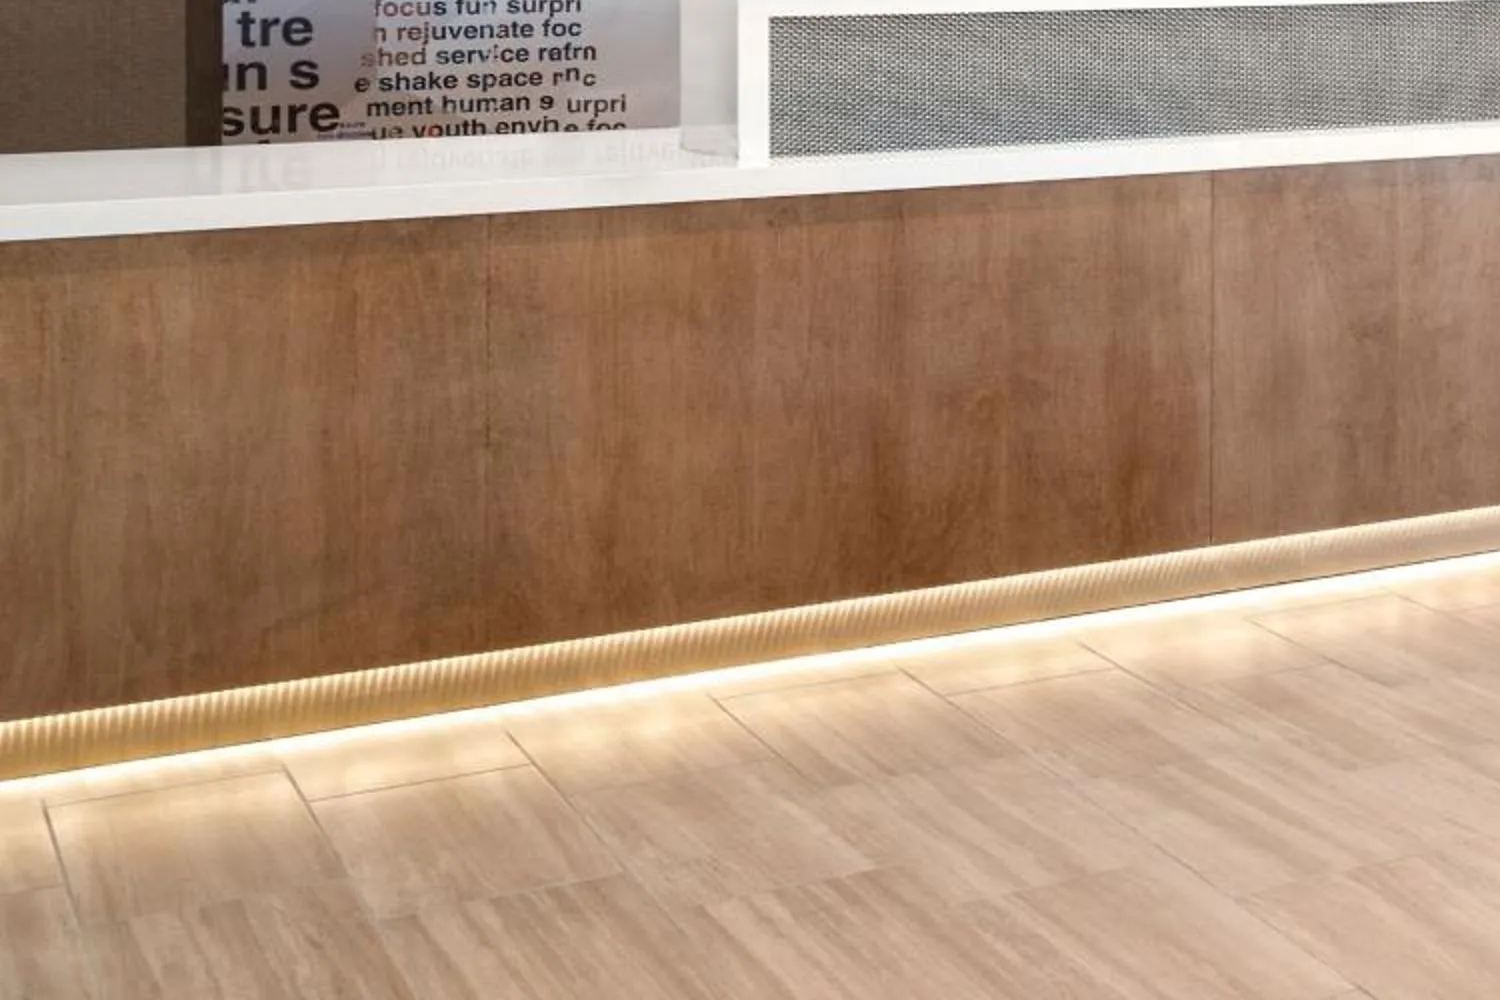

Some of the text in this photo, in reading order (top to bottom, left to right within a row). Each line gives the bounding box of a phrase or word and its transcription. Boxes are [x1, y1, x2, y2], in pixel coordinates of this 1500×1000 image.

[235, 11, 314, 48] tre
[397, 20, 535, 45] rejuvenate
[542, 17, 582, 38] foc
[360, 47, 426, 67] shed
[435, 43, 529, 65] service
[222, 59, 320, 92] n s
[354, 76, 370, 93] e
[378, 71, 459, 91] shake
[466, 71, 543, 93] space
[222, 101, 341, 137] sure
[366, 96, 433, 117] ment
[441, 95, 531, 114] human
[566, 93, 627, 118] urpri
